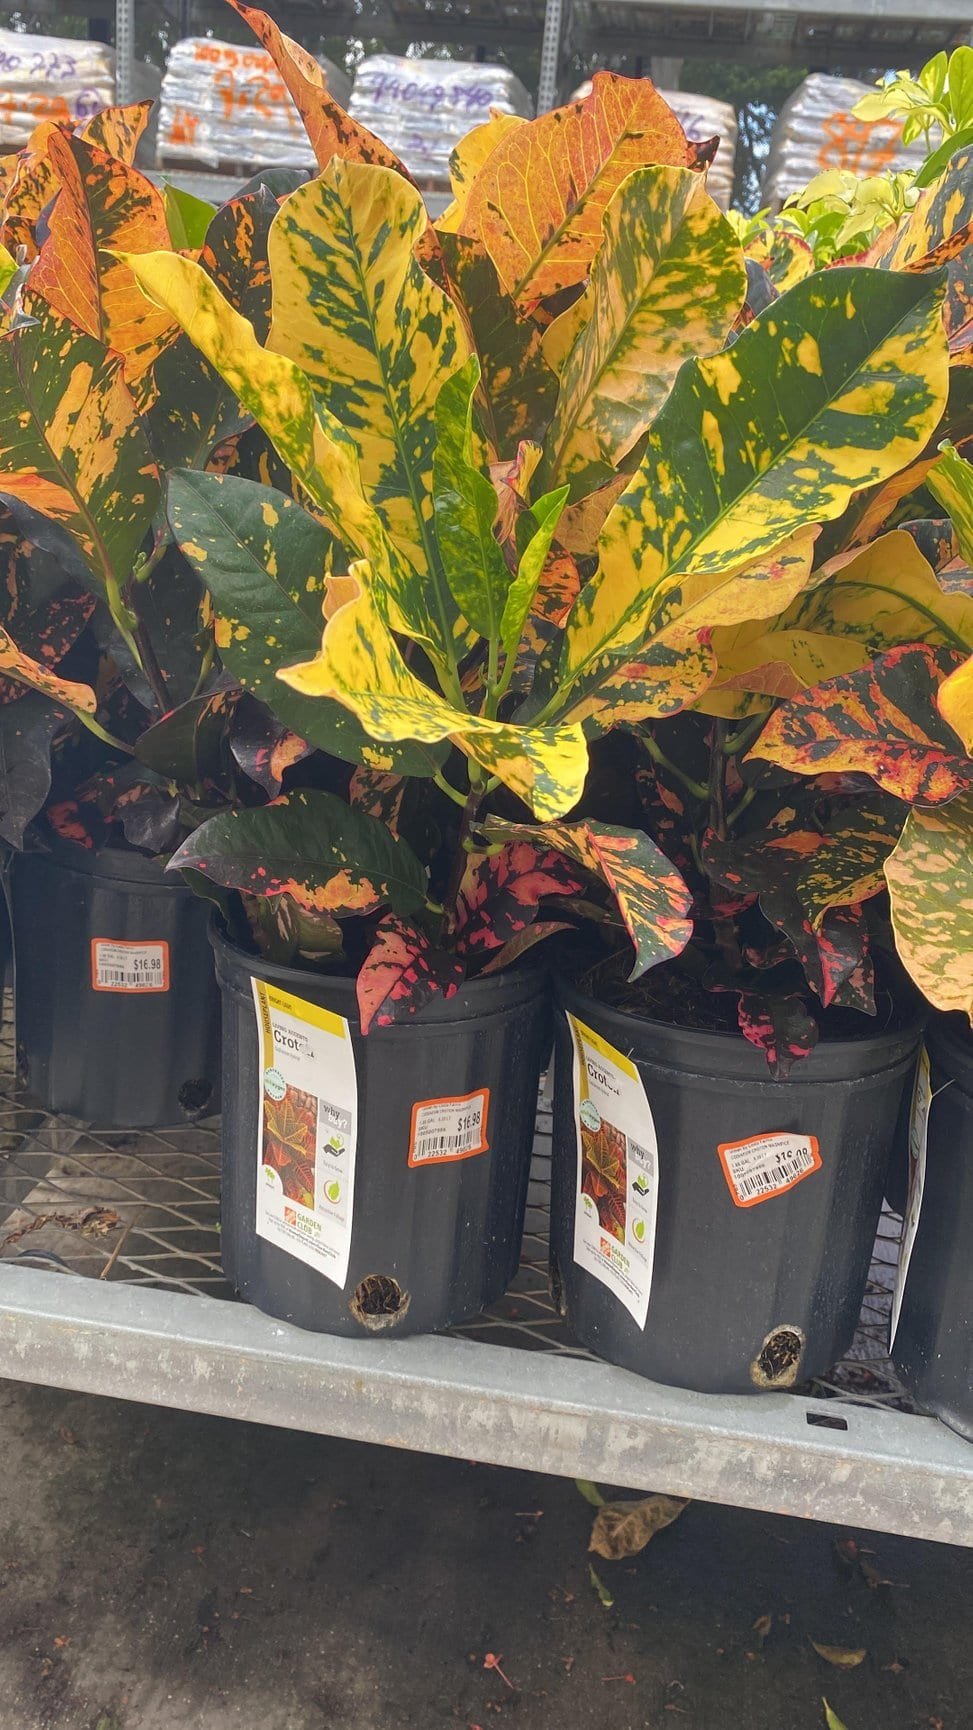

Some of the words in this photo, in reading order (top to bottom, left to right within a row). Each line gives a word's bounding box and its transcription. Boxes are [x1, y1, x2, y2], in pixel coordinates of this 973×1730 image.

[134, 959, 161, 970] $16.98
[274, 1030, 315, 1058] Crot
[588, 1063, 620, 1096] Crot
[323, 1104, 340, 1120] why
[458, 1112, 480, 1132] $16.98
[428, 1149, 447, 1157] 22532
[775, 1148, 808, 1163] $1698
[756, 1184, 777, 1194] 22532
[297, 1213, 321, 1231] GARDEN
